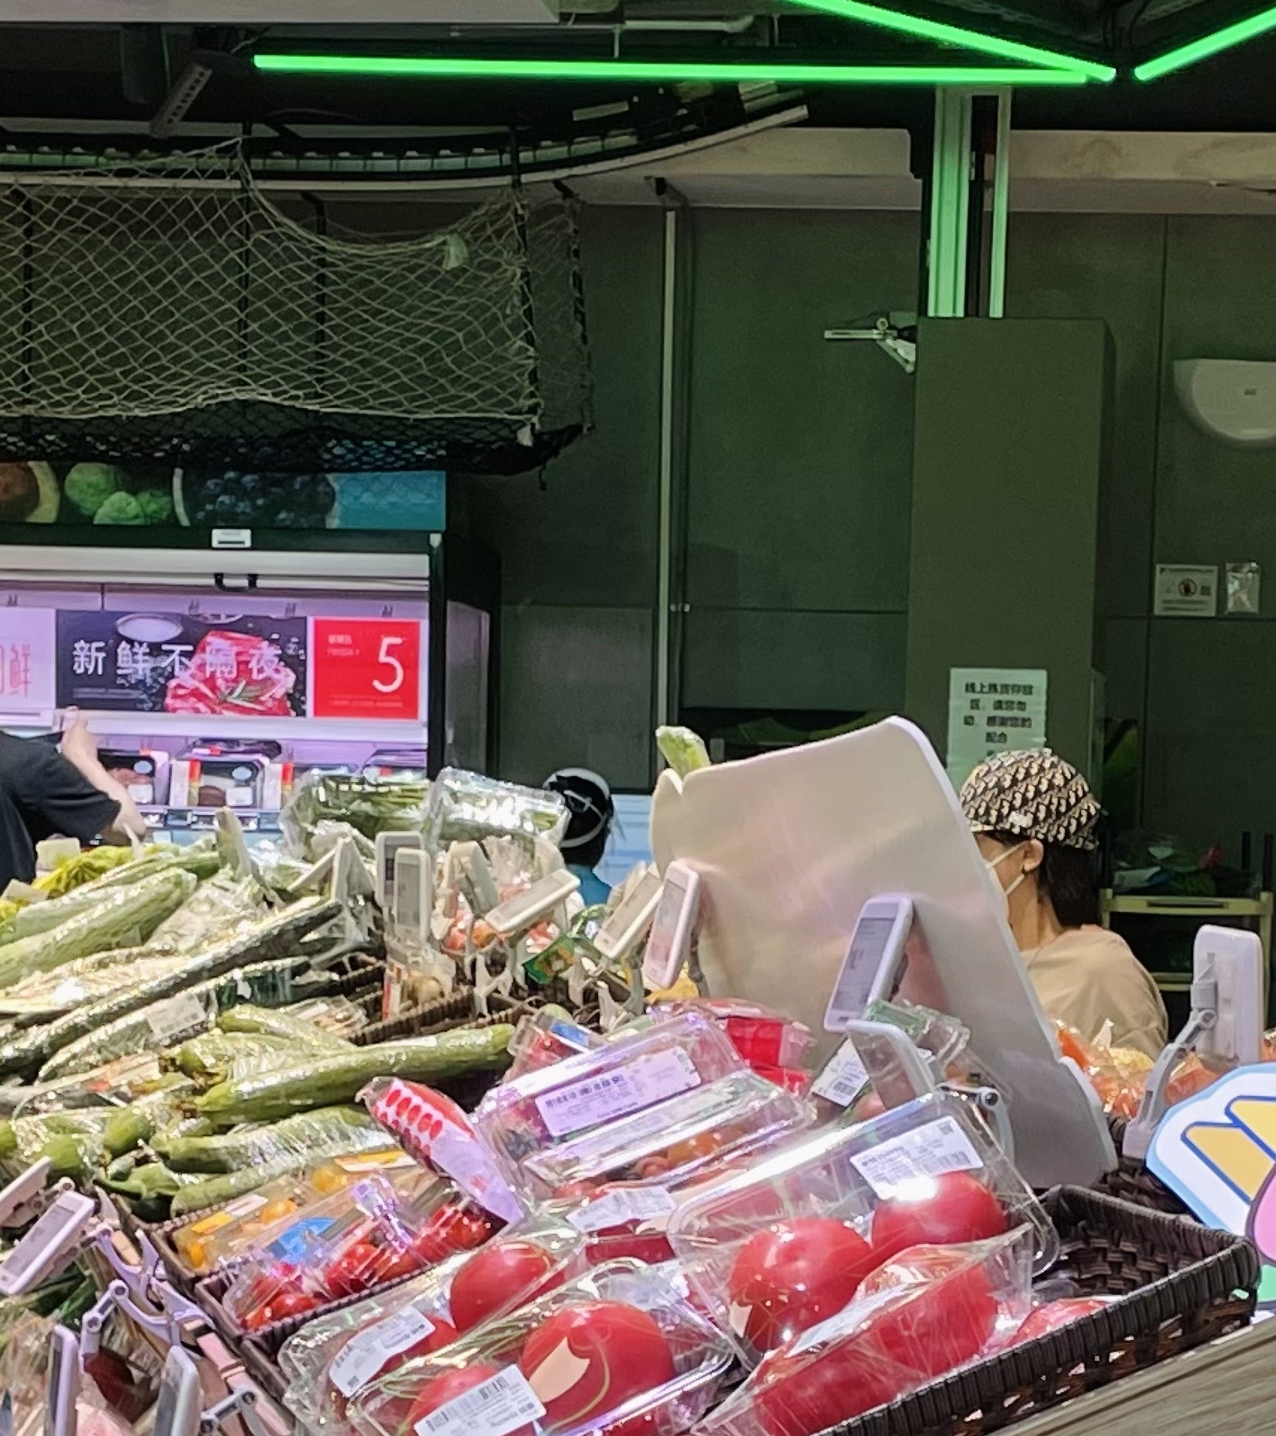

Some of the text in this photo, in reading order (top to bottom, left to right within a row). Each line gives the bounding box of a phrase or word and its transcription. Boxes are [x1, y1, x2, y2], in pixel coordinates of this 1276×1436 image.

[71, 639, 283, 682] 新鲜不隔夜
[371, 636, 404, 693] 5
